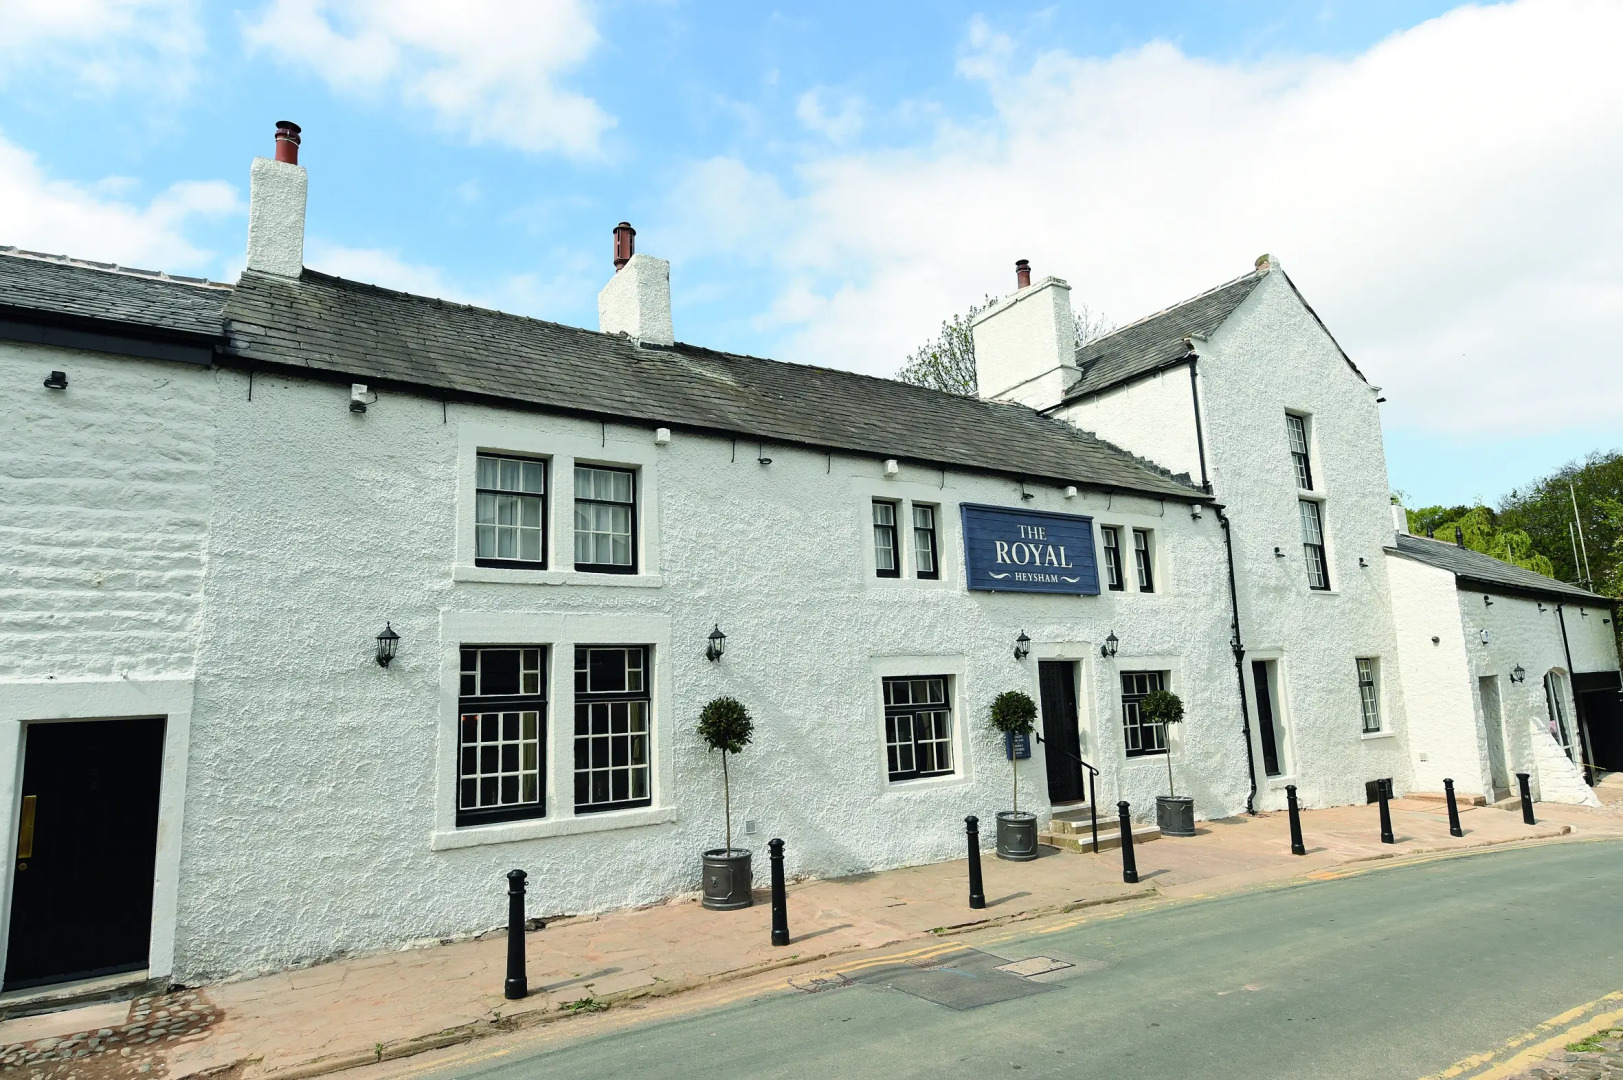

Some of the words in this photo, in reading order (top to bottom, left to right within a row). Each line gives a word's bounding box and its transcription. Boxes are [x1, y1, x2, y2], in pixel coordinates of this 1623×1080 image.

[1017, 524, 1047, 541] THE
[994, 540, 1073, 568] ROYAL
[1015, 572, 1059, 583] HEYSHAM
